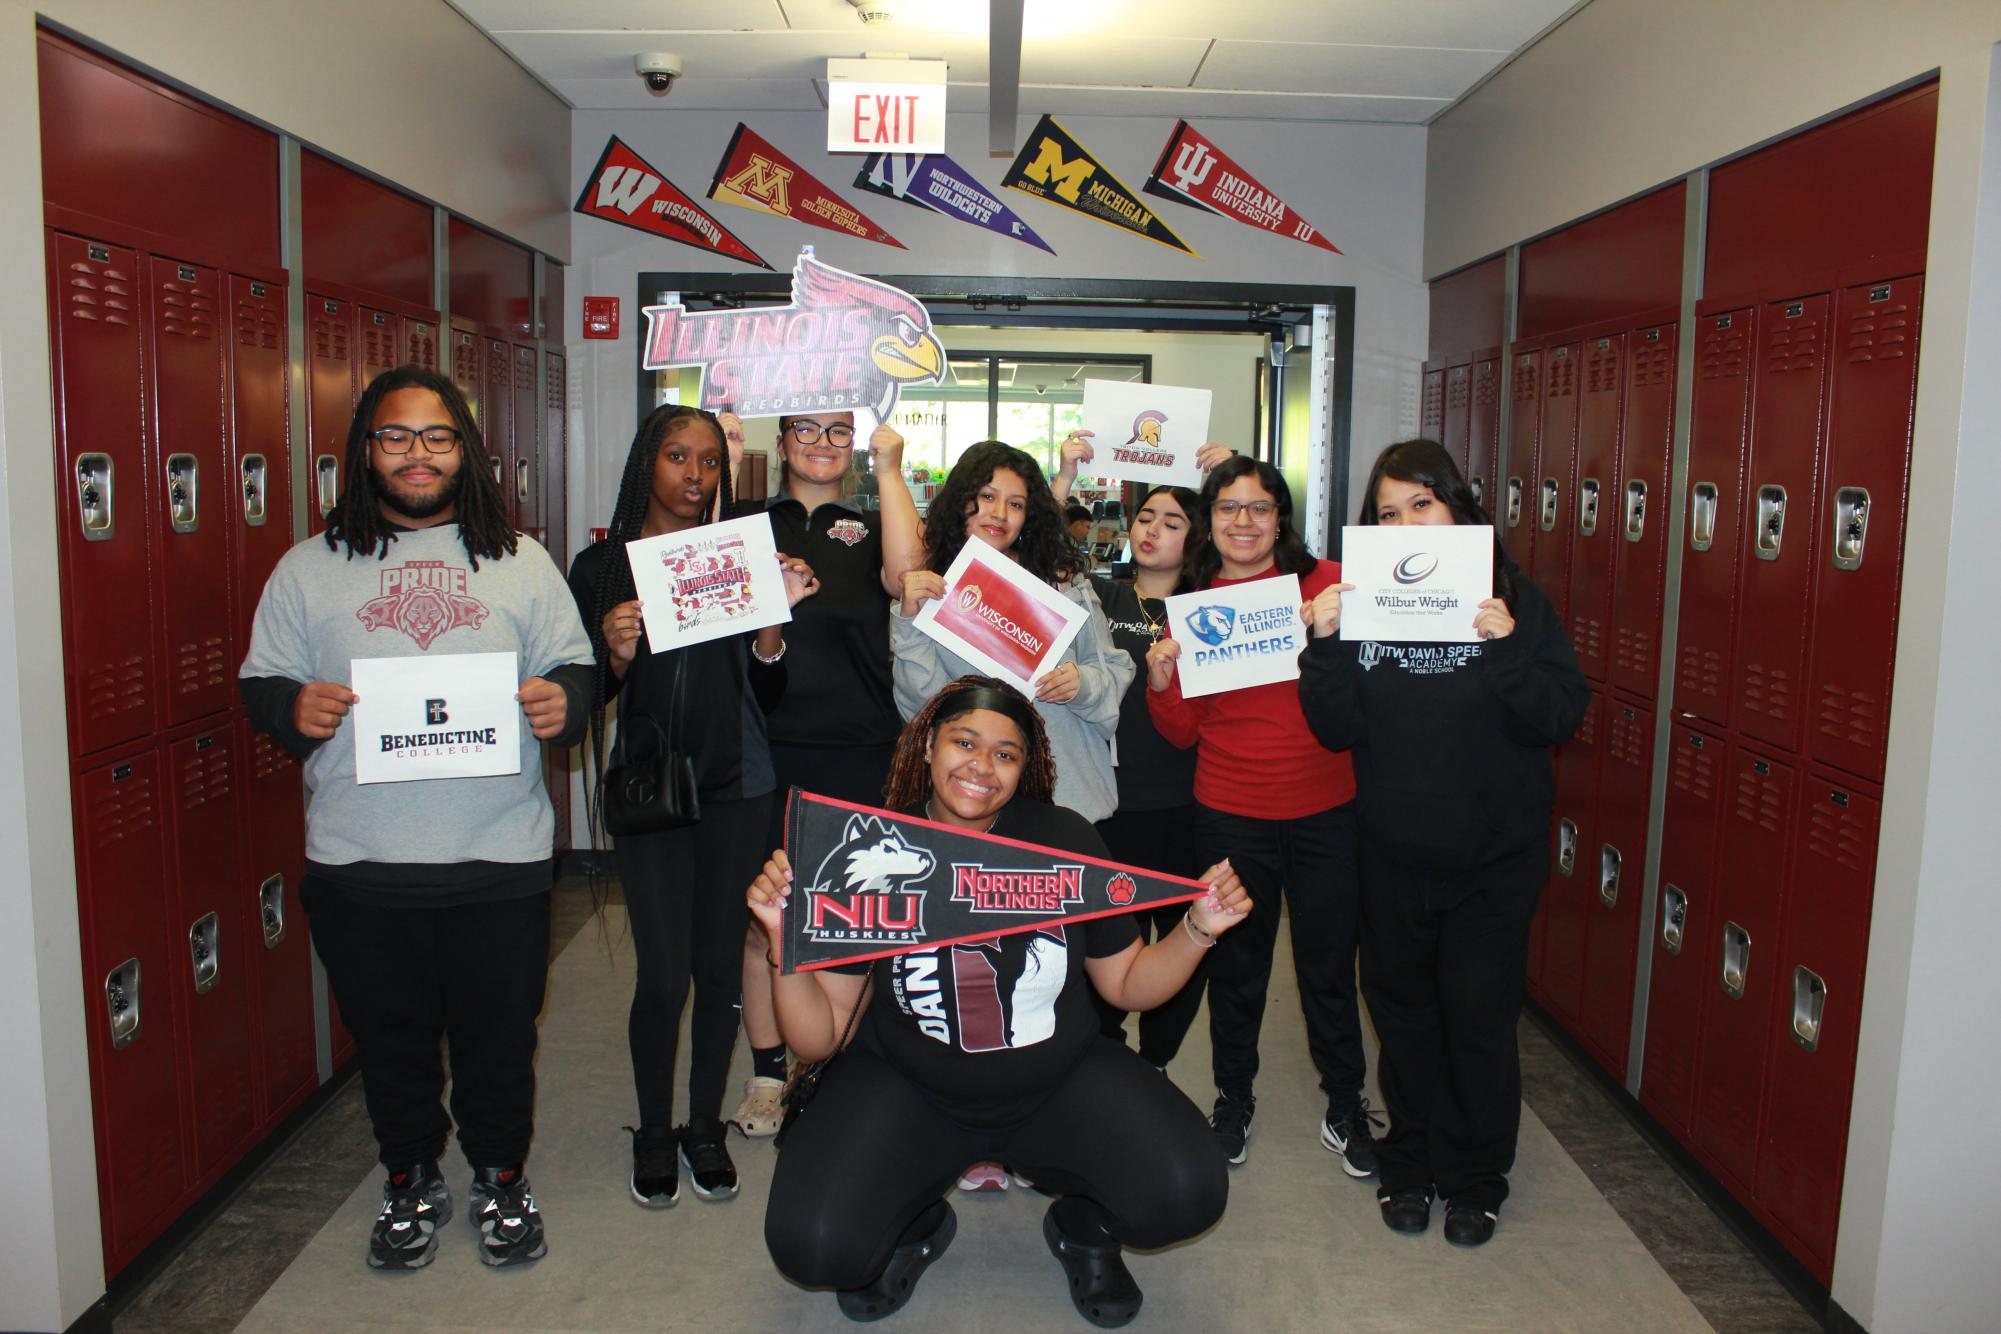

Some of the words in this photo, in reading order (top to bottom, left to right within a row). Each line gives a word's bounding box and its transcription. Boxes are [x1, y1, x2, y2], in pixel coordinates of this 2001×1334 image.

[854, 94, 920, 144] EXIT
[724, 153, 794, 217] M
[1023, 136, 1097, 205] M
[596, 166, 662, 216] W
[928, 181, 992, 224] WILDCATS
[929, 168, 1003, 215] NORTHWESTERN
[1018, 180, 1027, 190] GO
[1026, 183, 1044, 197] BLUE
[1087, 180, 1153, 227] MICHIGAN
[1216, 171, 1286, 221] INDIANA
[651, 200, 723, 248] WISCONSIN
[801, 199, 832, 221] GOLDEN
[832, 216, 868, 237] GOPHERS
[816, 196, 860, 223] MINNESOTA
[1211, 187, 1281, 231] UNIVERSITY
[1293, 221, 1316, 242] IU
[651, 308, 873, 364] ILLINOIS
[706, 351, 864, 406] STATE
[743, 393, 861, 411] REDBIRDS
[1113, 449, 1175, 467] TROJANS
[382, 567, 466, 595] PRIDE
[676, 573, 715, 596] ILLINOIS
[714, 567, 744, 586] STATE
[1239, 606, 1293, 625] EASTERN
[1375, 596, 1417, 607] Wilbur
[1418, 596, 1458, 611] Wright
[978, 601, 1043, 653] WISCONSIN
[1243, 616, 1292, 635] ILLINOIS
[1194, 636, 1295, 667] PANTHERS
[1381, 645, 1405, 659] ITW
[1447, 645, 1481, 658] SPEE
[1409, 658, 1457, 669] ACADEMY
[426, 698, 449, 726] B
[380, 727, 497, 753] BENEDICTINE
[396, 745, 483, 759] COLLEGE
[957, 867, 1080, 899] NORTHERN
[812, 894, 918, 930] NIU
[976, 892, 1059, 910] ILLINOIS
[820, 930, 910, 940] HUSKIES
[892, 953, 903, 974] PR
[892, 977, 913, 1016] SPEER
[904, 946, 951, 1046] DAN
